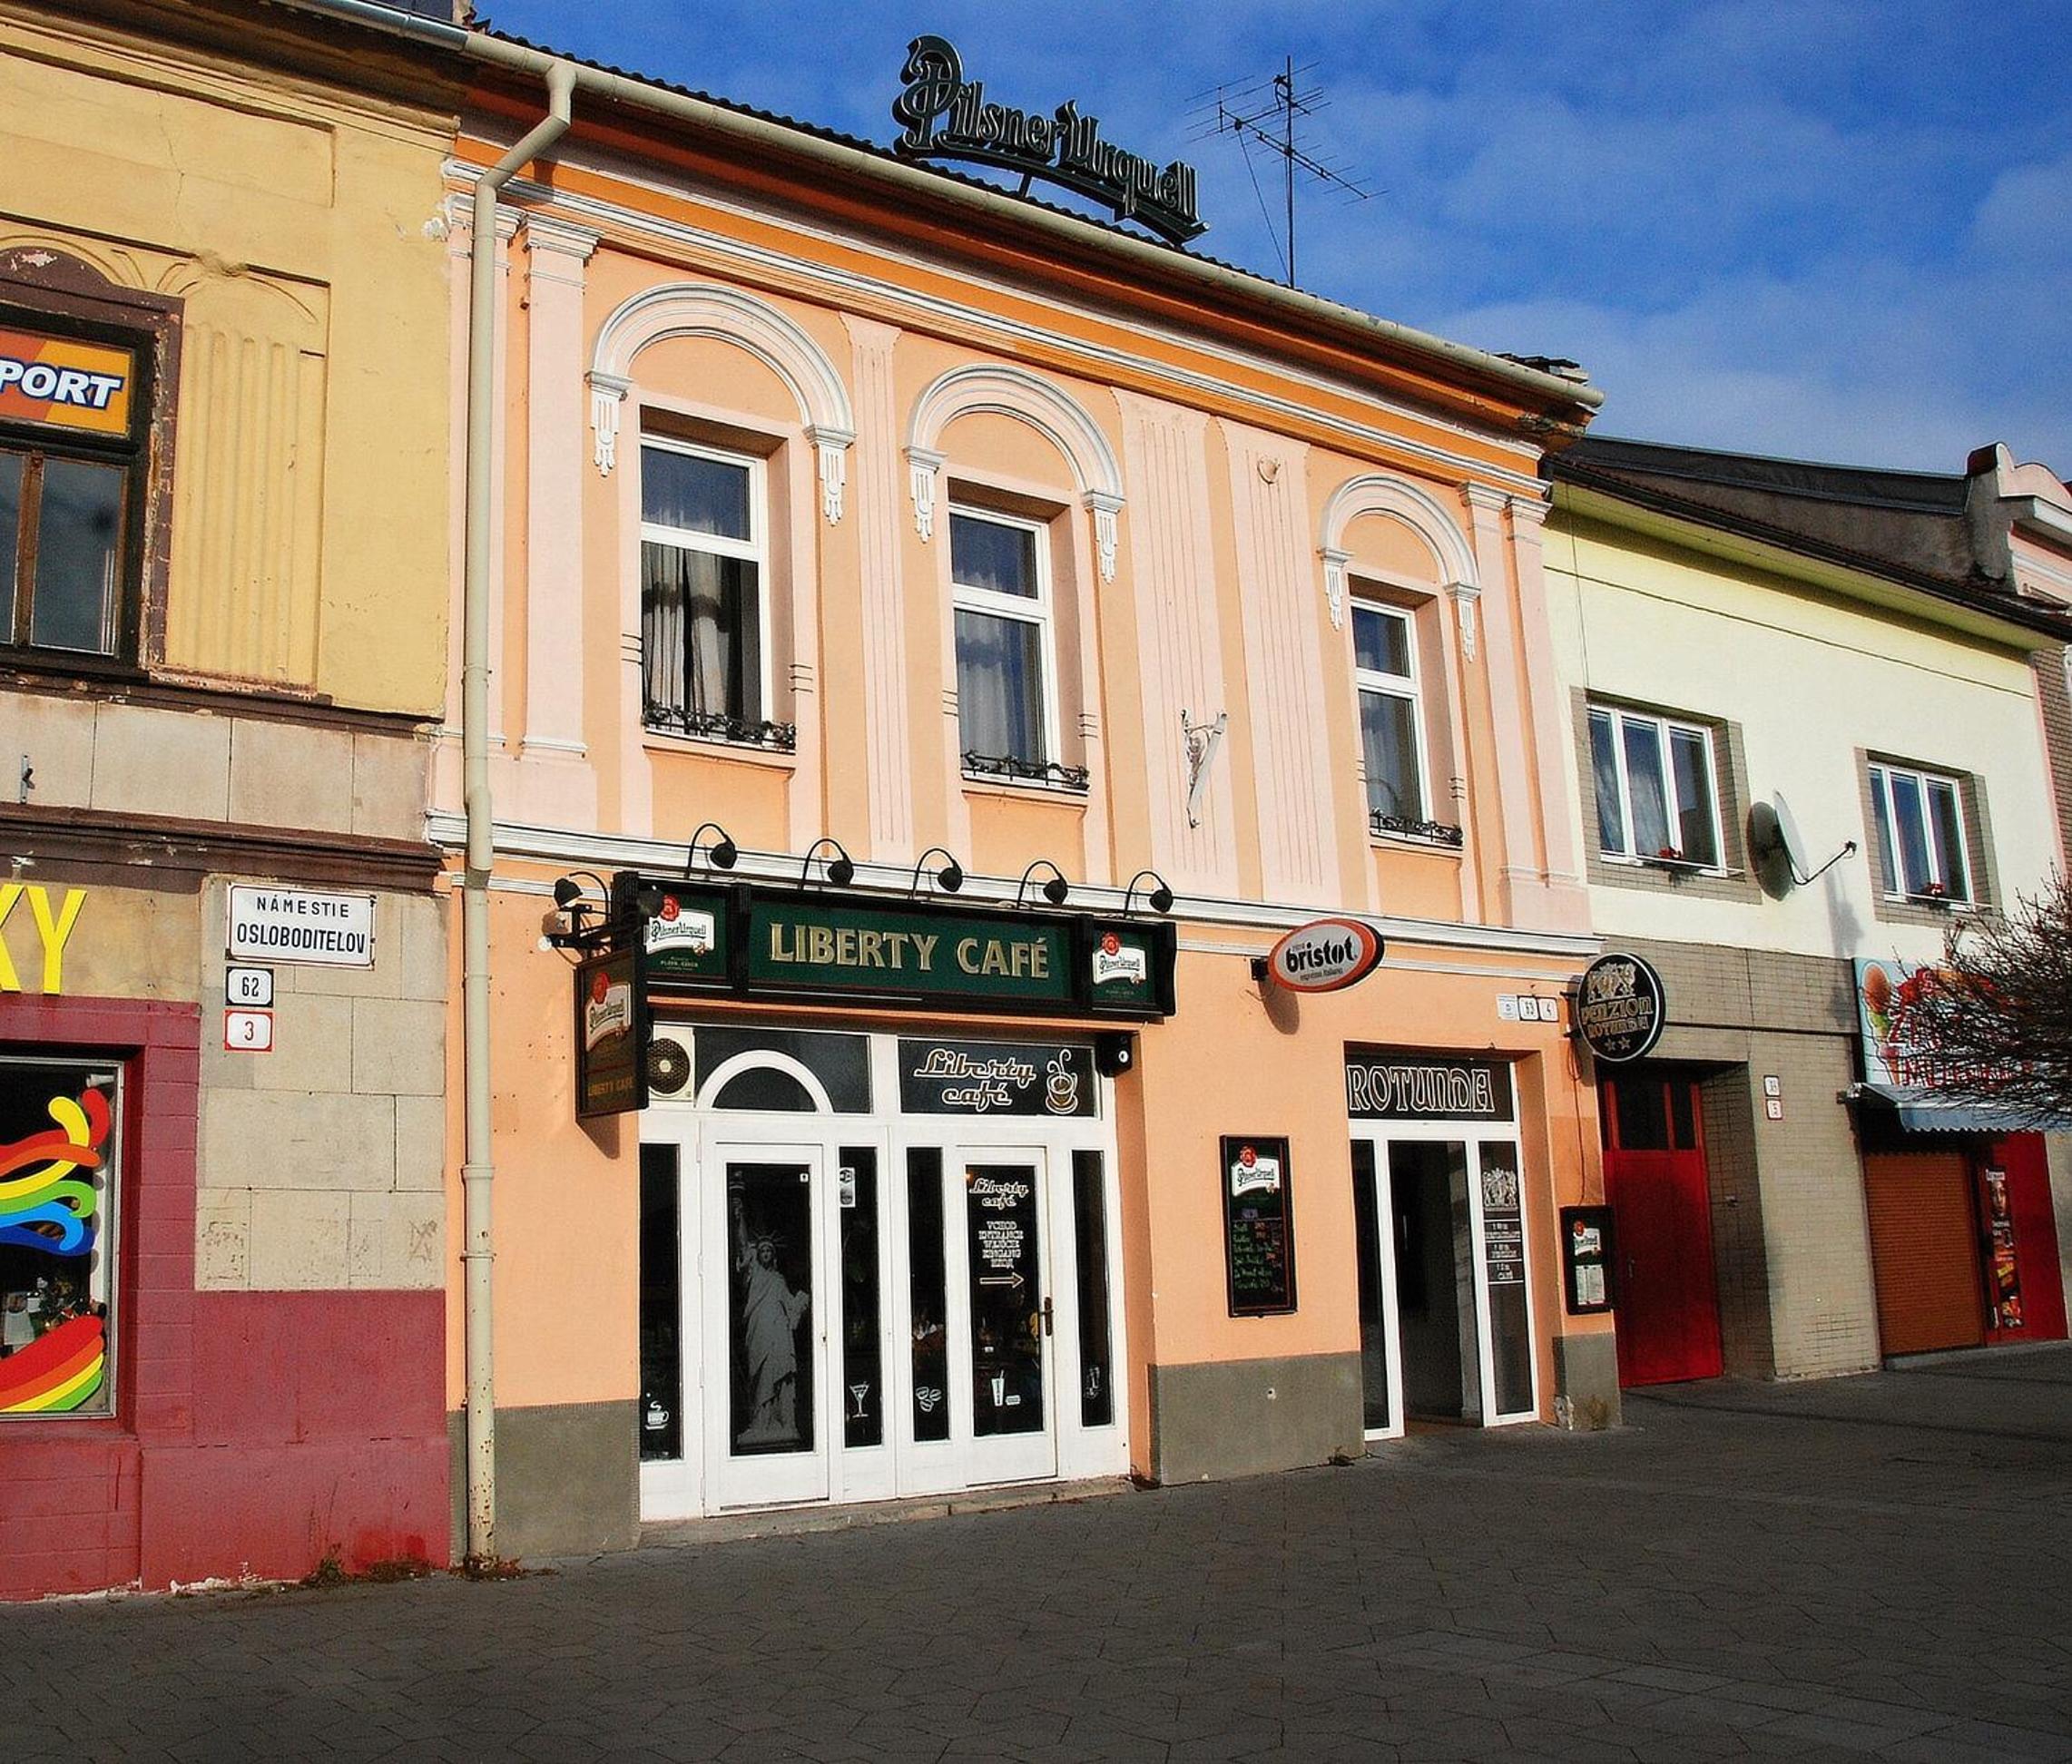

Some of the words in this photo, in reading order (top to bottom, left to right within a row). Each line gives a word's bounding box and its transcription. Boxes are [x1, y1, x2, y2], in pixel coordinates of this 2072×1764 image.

[892, 34, 1067, 155] Pilsner
[1056, 100, 1201, 221] Urquell
[256, 895, 349, 918] NÁMESTIE
[769, 923, 939, 972] LIBERTY
[956, 937, 1050, 979] CAFÉ
[1285, 936, 1357, 973] bristot
[241, 976, 260, 997] 62
[244, 1021, 255, 1041] 3
[914, 1048, 1037, 1089] Liberty
[942, 1081, 1013, 1112] café
[1346, 1065, 1496, 1113] ROTUNDA
[969, 1178, 1029, 1198] Liberty
